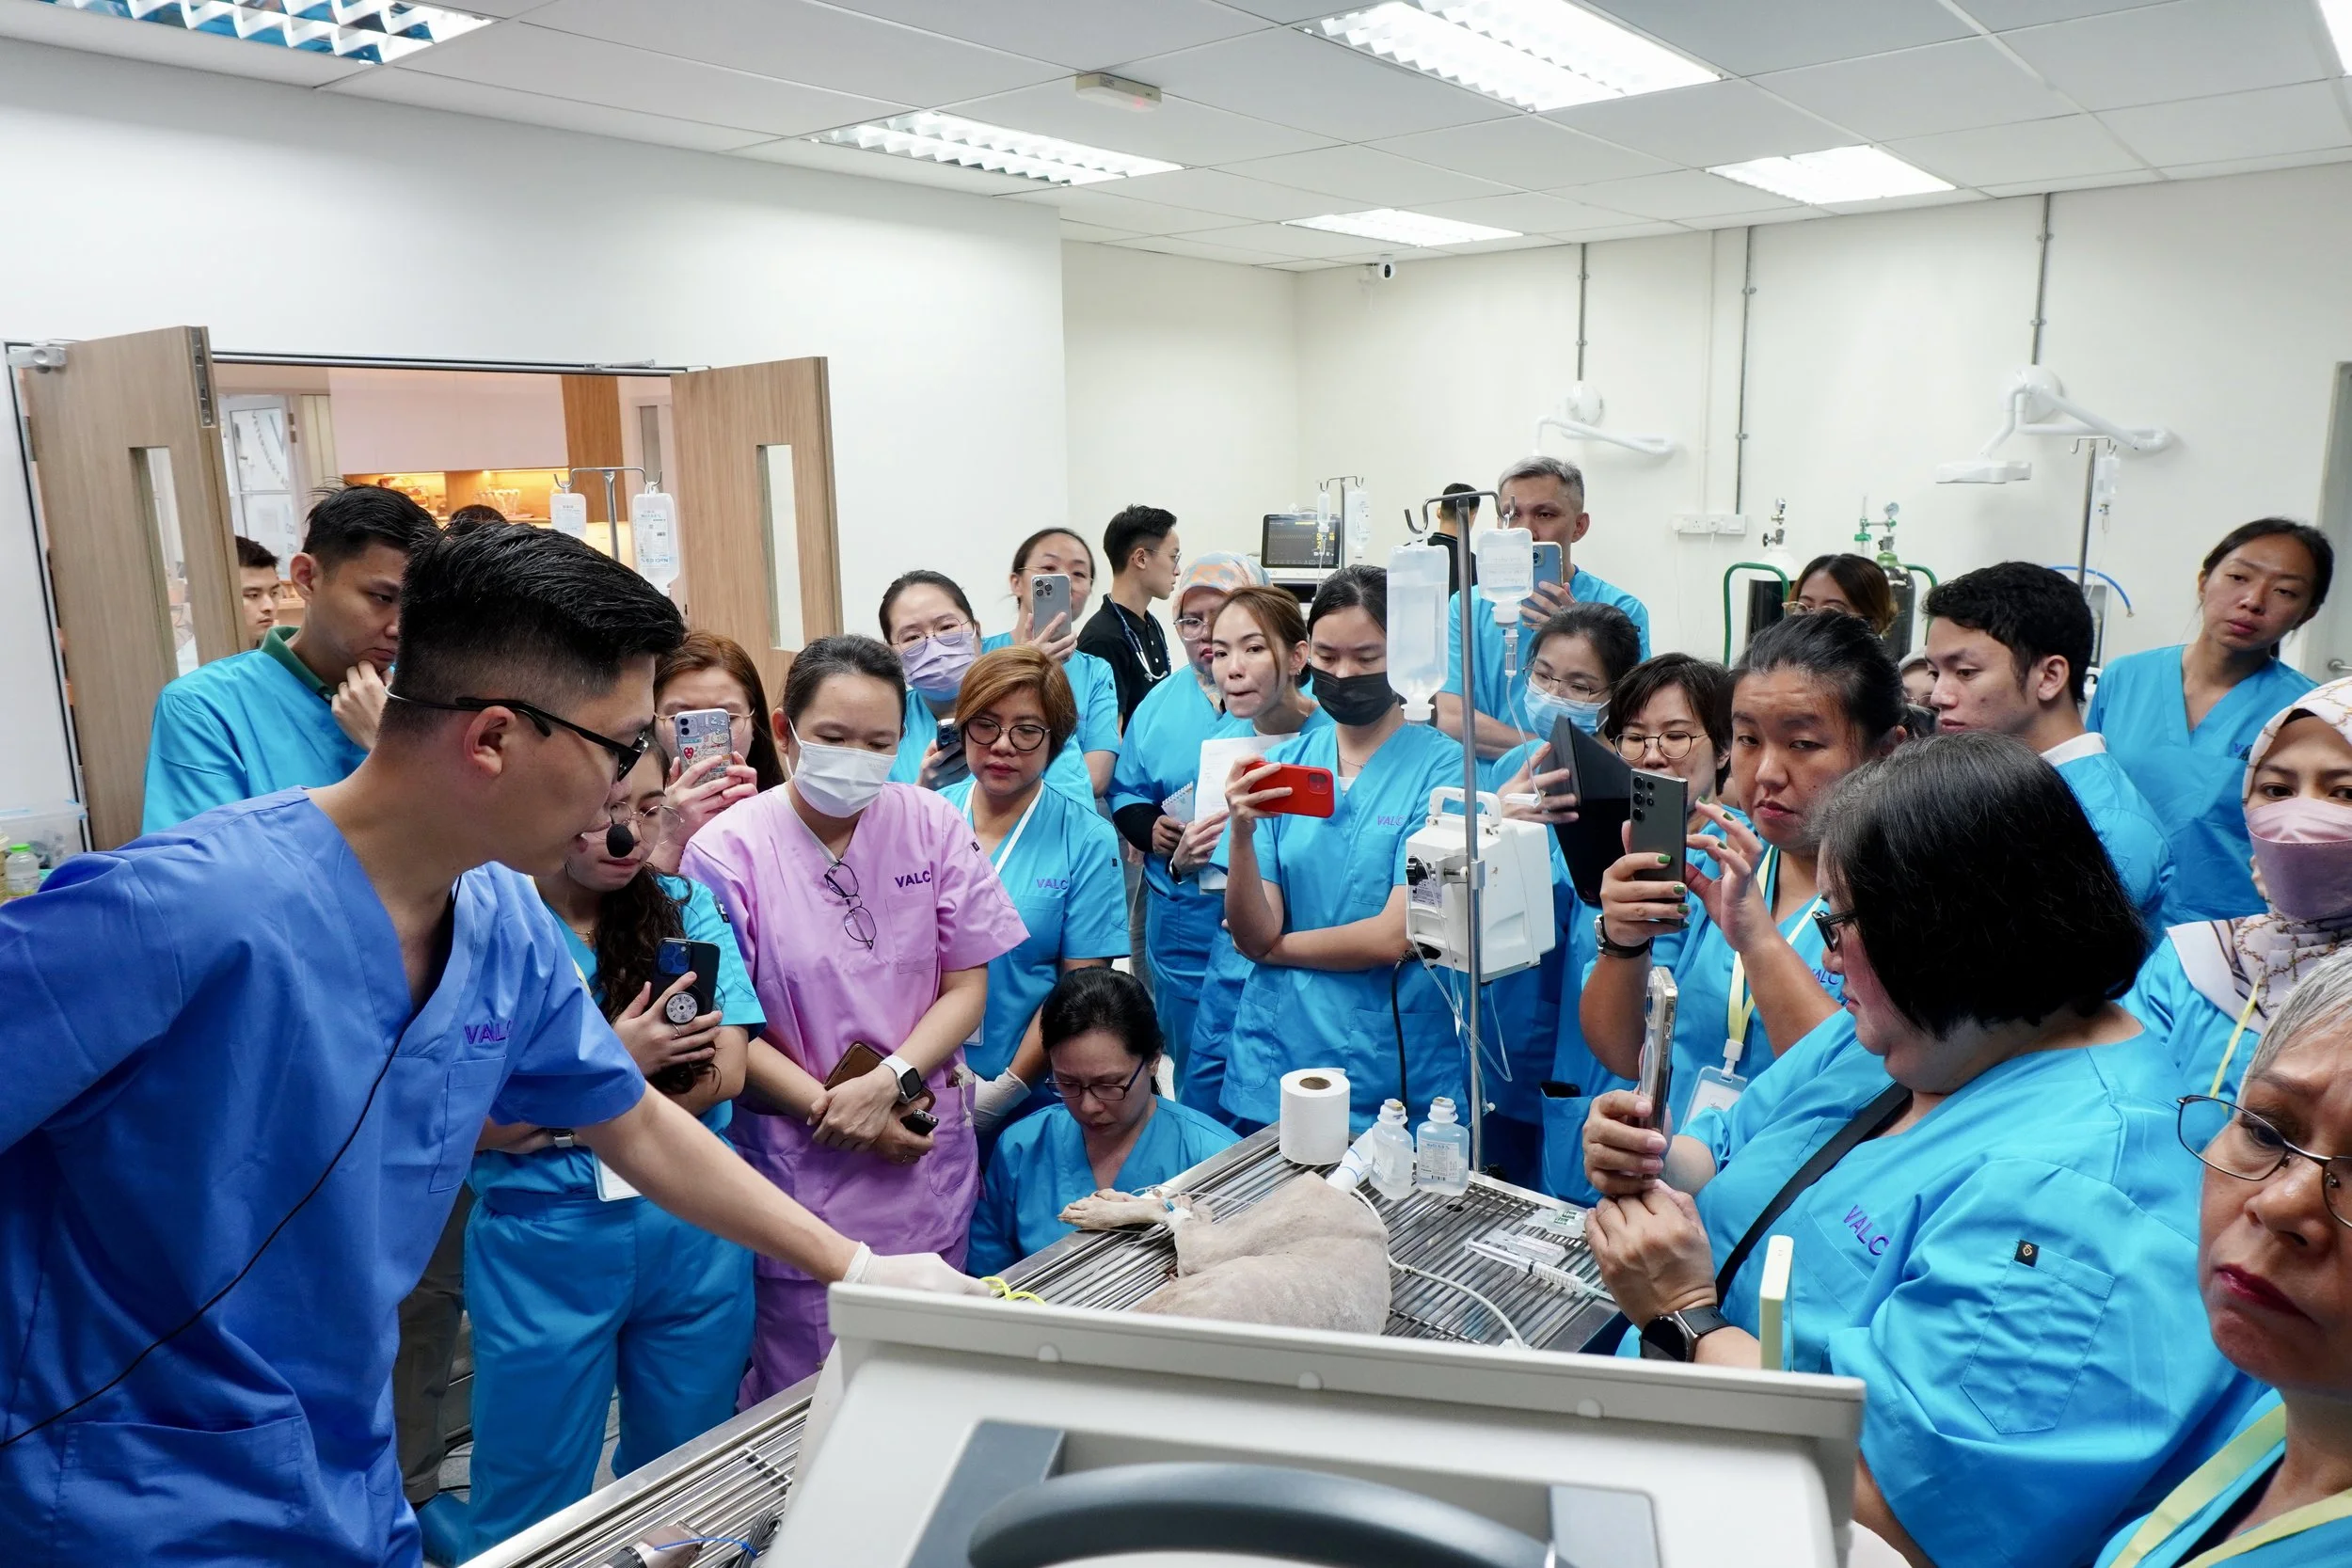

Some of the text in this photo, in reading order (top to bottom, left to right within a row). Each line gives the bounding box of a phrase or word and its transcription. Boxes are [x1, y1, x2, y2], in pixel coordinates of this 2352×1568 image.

[1377, 815, 1405, 826] VALC
[895, 870, 931, 888] VALC
[1036, 879, 1068, 890] VALC
[1812, 968, 1840, 986] ALC
[1844, 1204, 1890, 1256] VALC
